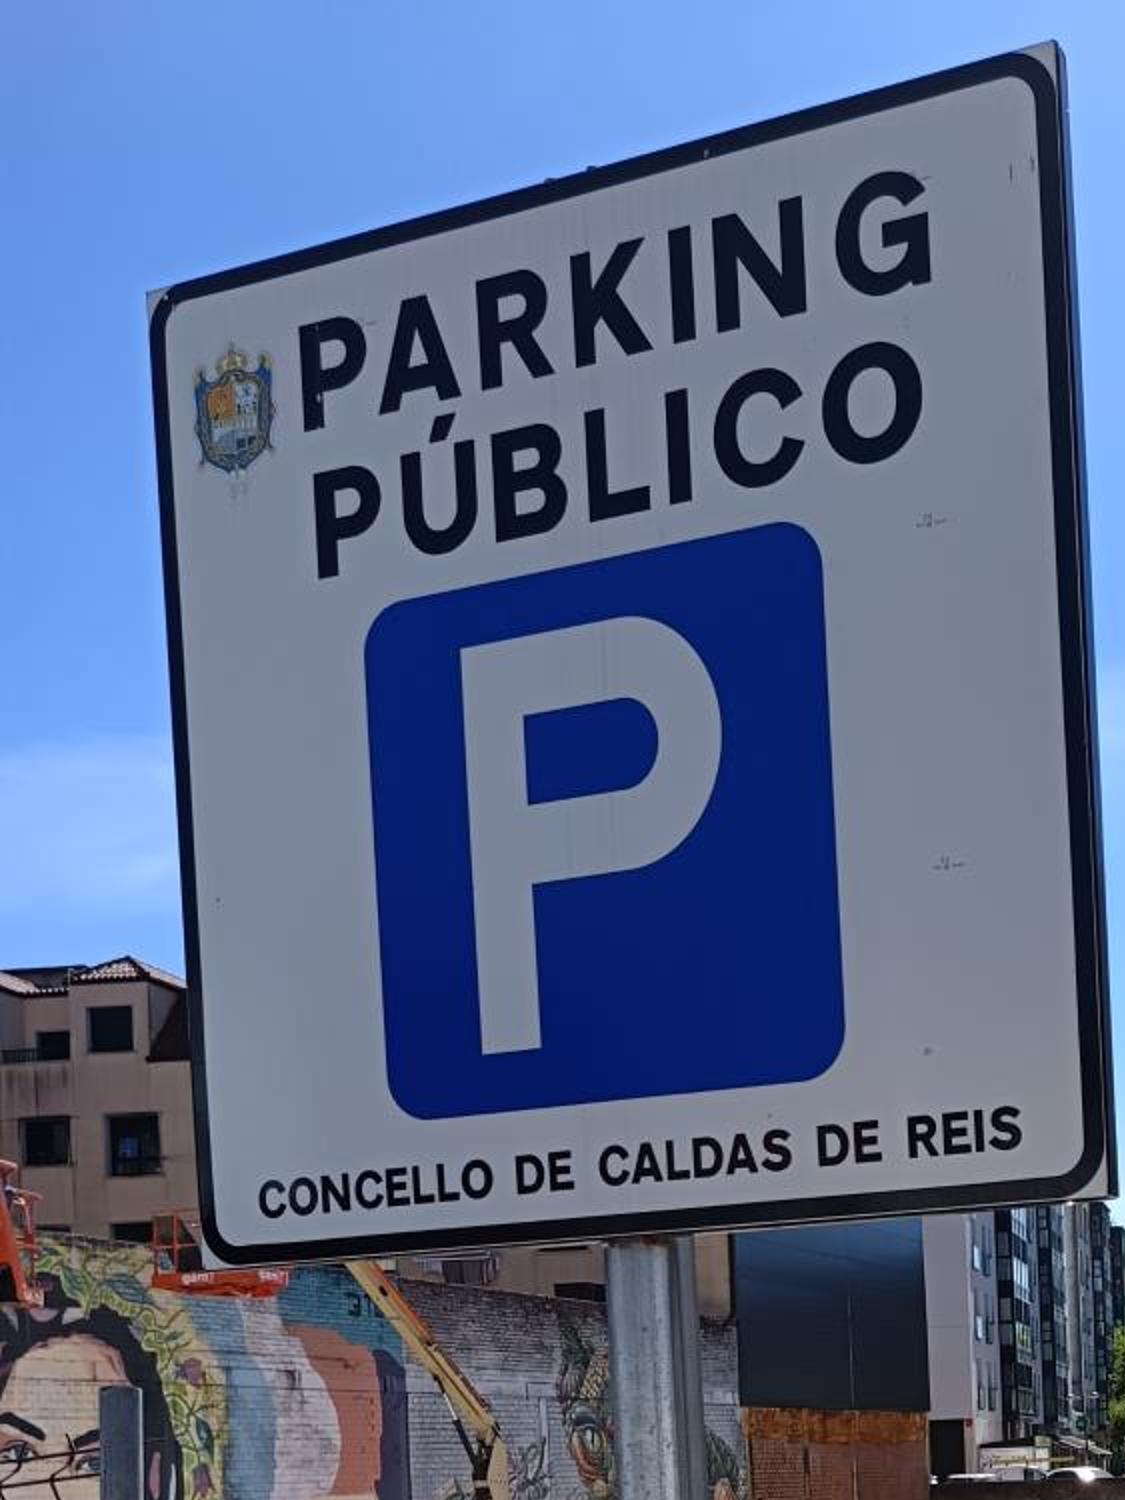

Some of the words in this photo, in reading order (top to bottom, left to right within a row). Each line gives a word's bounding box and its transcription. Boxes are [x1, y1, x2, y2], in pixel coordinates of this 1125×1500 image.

[298, 169, 933, 433] PARKING
[312, 340, 924, 580] PÚBLICO
[460, 614, 724, 1056] P
[258, 1158, 495, 1220] CONCELLO
[513, 1149, 575, 1197] DE
[598, 1128, 794, 1188] CALDAS
[816, 1118, 883, 1168] DE
[906, 1104, 1023, 1160] REIS
